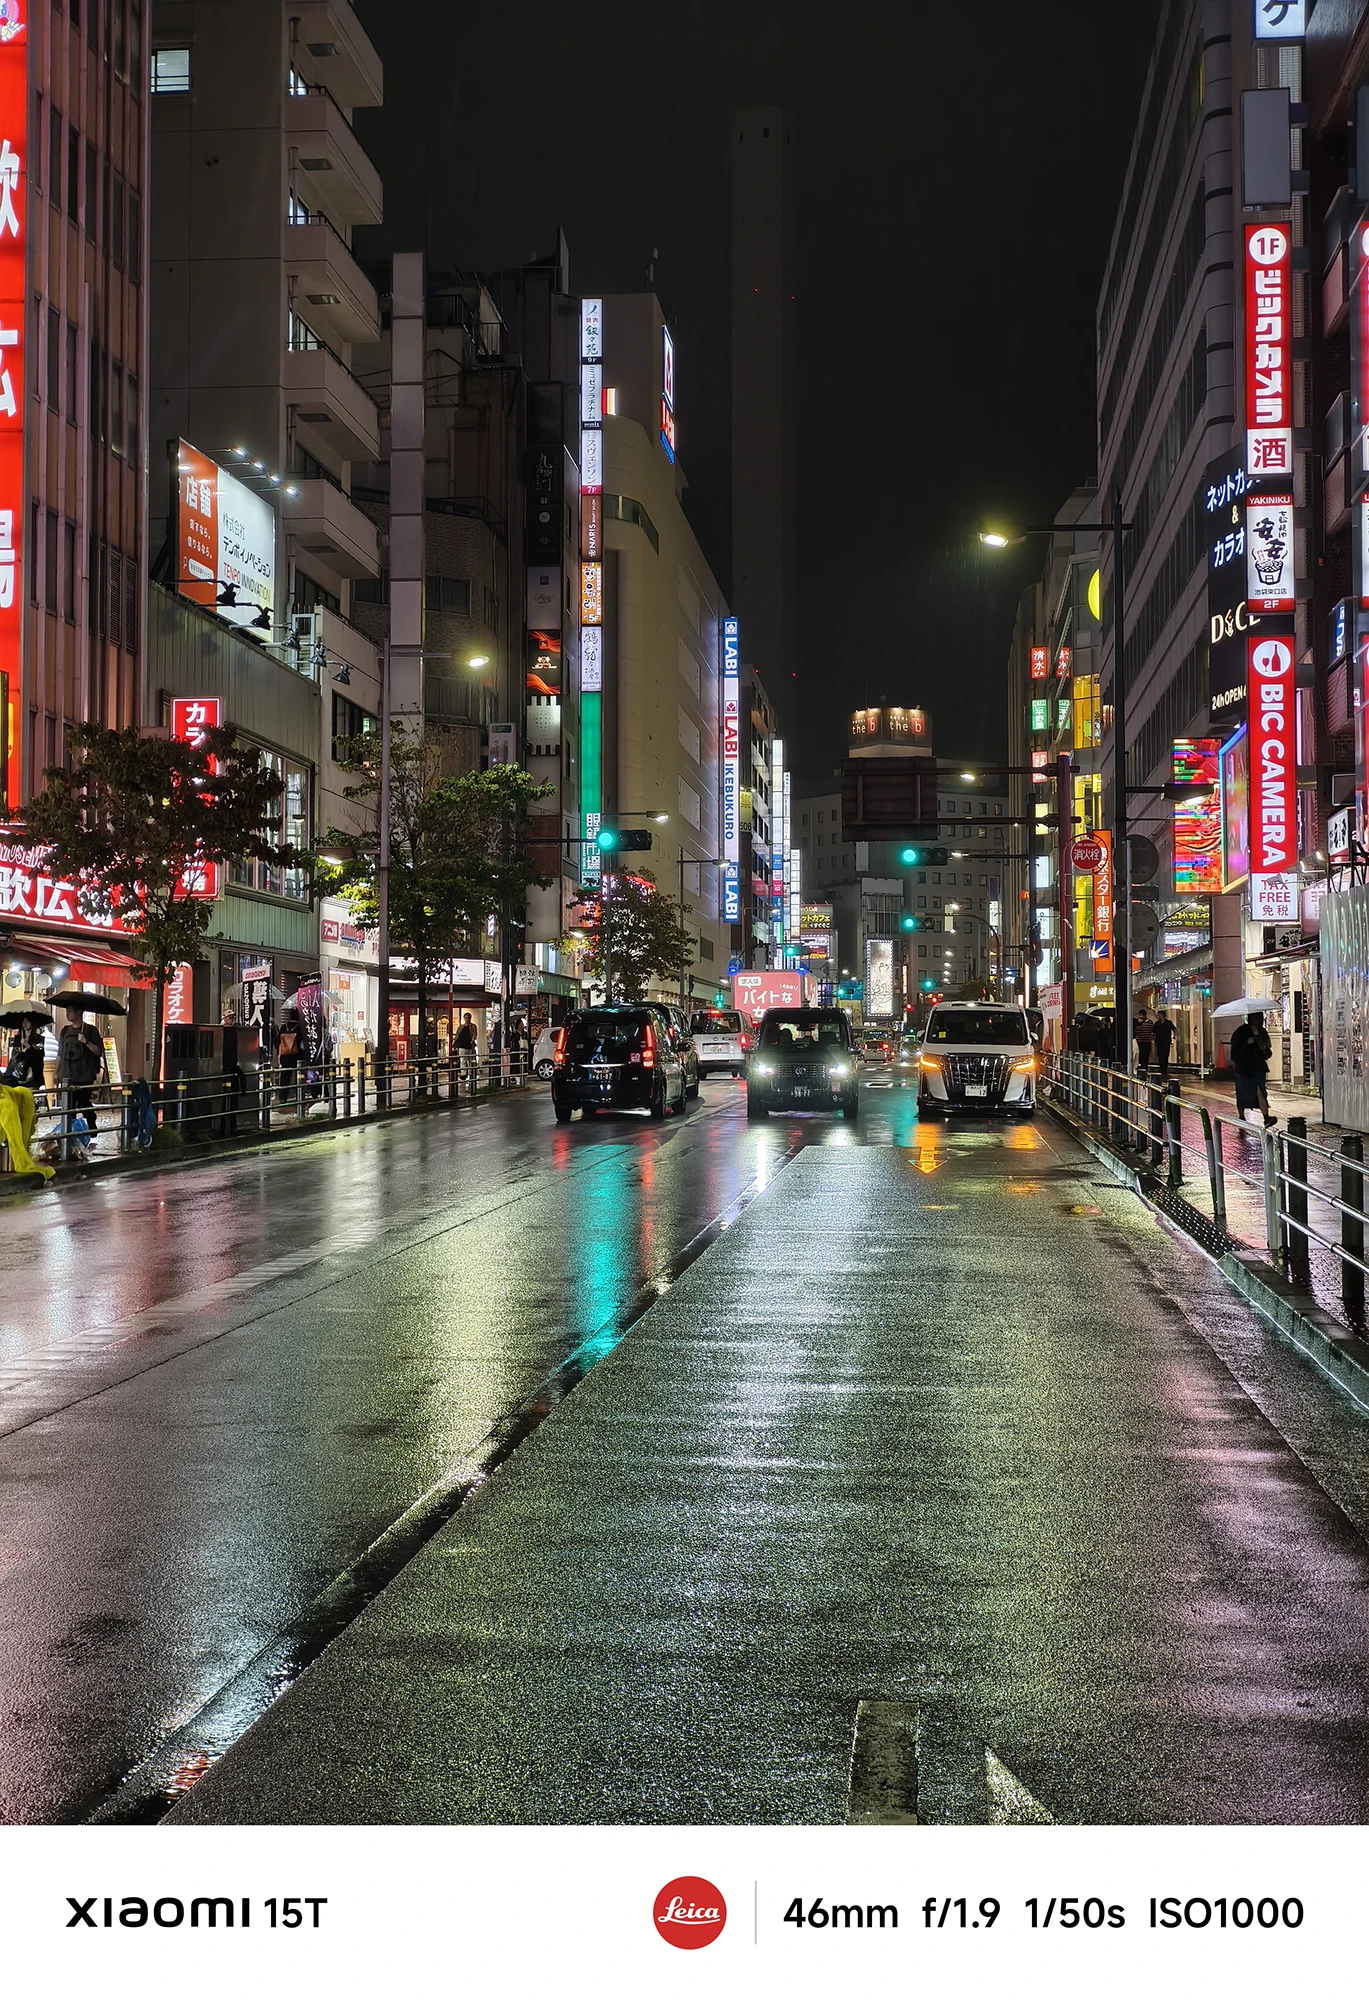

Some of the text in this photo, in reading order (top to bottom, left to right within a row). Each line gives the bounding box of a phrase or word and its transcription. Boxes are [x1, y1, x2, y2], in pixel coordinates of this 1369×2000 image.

[1256, 236, 1280, 256] 1F
[1254, 269, 1283, 424] ビックカメラ
[1253, 438, 1287, 469] 酒
[1249, 496, 1290, 505] YAKINIKU
[1231, 505, 1239, 524] &
[223, 511, 246, 541] 株式会社
[223, 535, 272, 578] テンポイノベーション
[223, 562, 241, 585] TENPO
[241, 577, 271, 603] INNOVATION
[1263, 600, 1279, 609] 2F
[588, 614, 599, 622] 5F
[725, 637, 737, 675] LABI
[1034, 651, 1045, 670] 清水
[852, 725, 866, 735] the
[889, 720, 908, 731] the
[725, 716, 737, 840] LABI IKEBUKURO
[1261, 684, 1286, 867] BIC CAMERA
[1073, 848, 1100, 861] 消火栓
[1261, 879, 1289, 890] TAX
[726, 881, 738, 919] LABI
[1259, 892, 1291, 902] FREE
[1262, 904, 1289, 917] 免税
[743, 989, 793, 1005] バイトな
